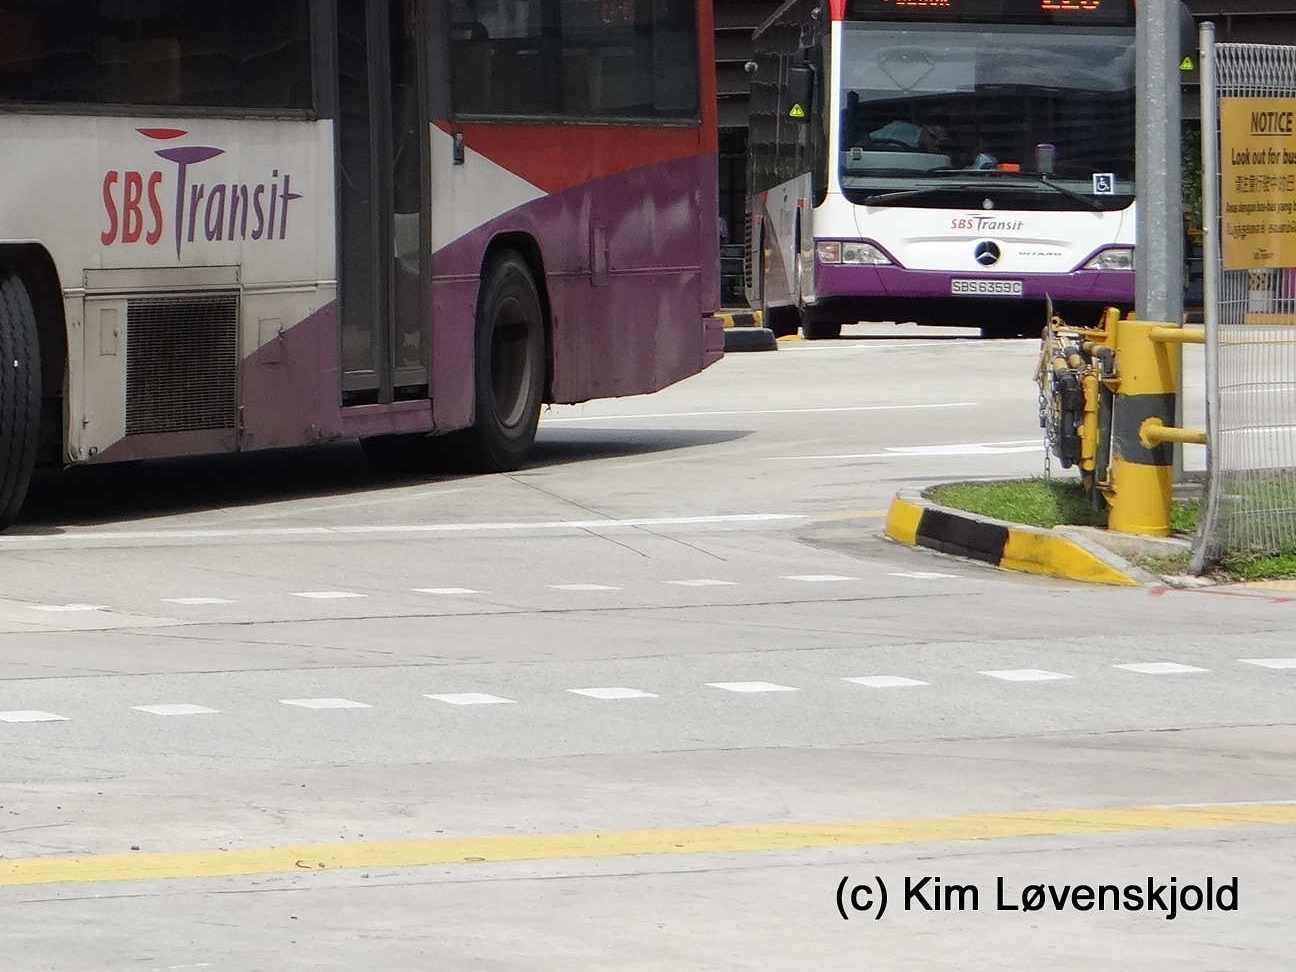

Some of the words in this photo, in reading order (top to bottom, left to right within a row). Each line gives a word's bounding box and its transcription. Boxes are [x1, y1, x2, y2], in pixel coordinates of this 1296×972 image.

[1250, 111, 1294, 133] NOTICE
[1231, 147, 1250, 166] Look
[1252, 147, 1266, 165] out
[1267, 147, 1281, 165] for
[101, 170, 163, 246] SBS
[154, 146, 303, 263] Transit
[950, 219, 973, 229] SBS
[971, 216, 1026, 231] Transit
[952, 281, 1021, 294] SBS6359C
